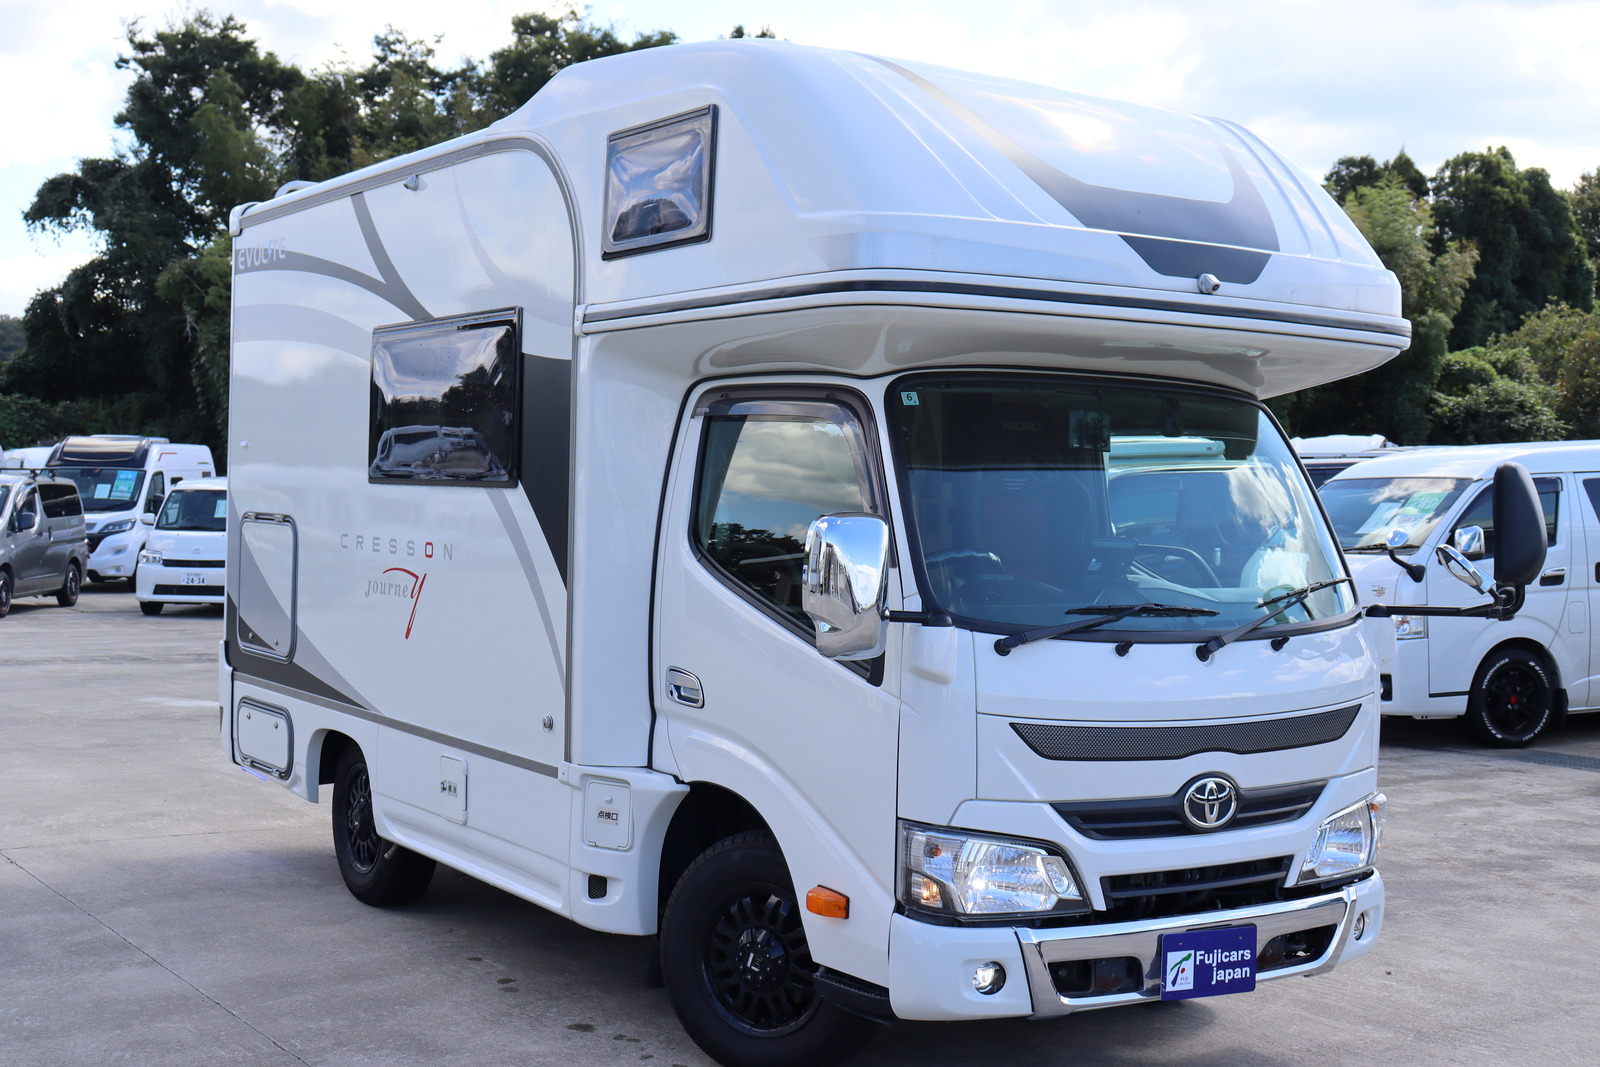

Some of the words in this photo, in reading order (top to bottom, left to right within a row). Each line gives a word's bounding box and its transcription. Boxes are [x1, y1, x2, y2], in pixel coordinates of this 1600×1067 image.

[906, 393, 913, 401] 6
[1410, 496, 1438, 510] 2WD
[340, 533, 453, 560] CRESSON
[1482, 657, 1509, 689] YOKOHAMA
[597, 810, 619, 821] 点検口
[1195, 948, 1252, 967] Fujicars
[1211, 966, 1251, 985] japan
